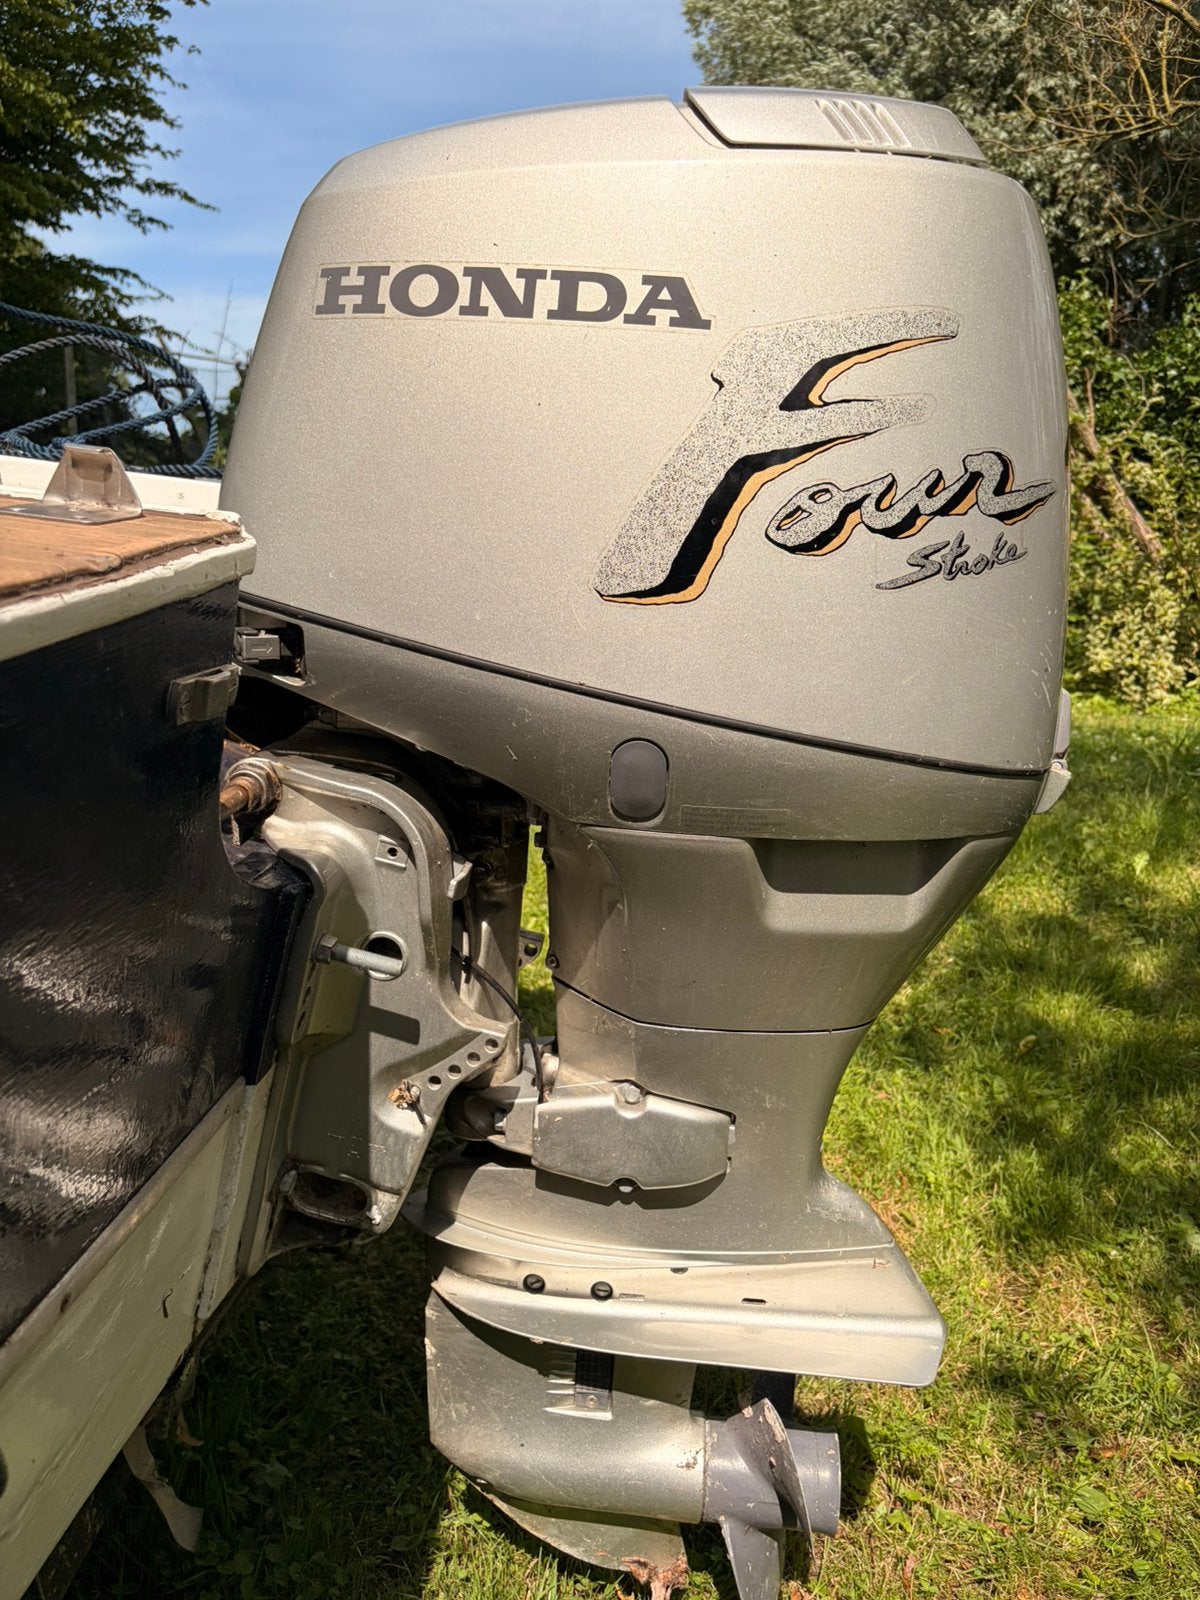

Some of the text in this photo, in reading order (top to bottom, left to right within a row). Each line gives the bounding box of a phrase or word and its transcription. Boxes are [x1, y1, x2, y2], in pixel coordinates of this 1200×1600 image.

[315, 264, 712, 330] HONDA
[594, 307, 1056, 606] Four
[875, 530, 1028, 590] Stroke
